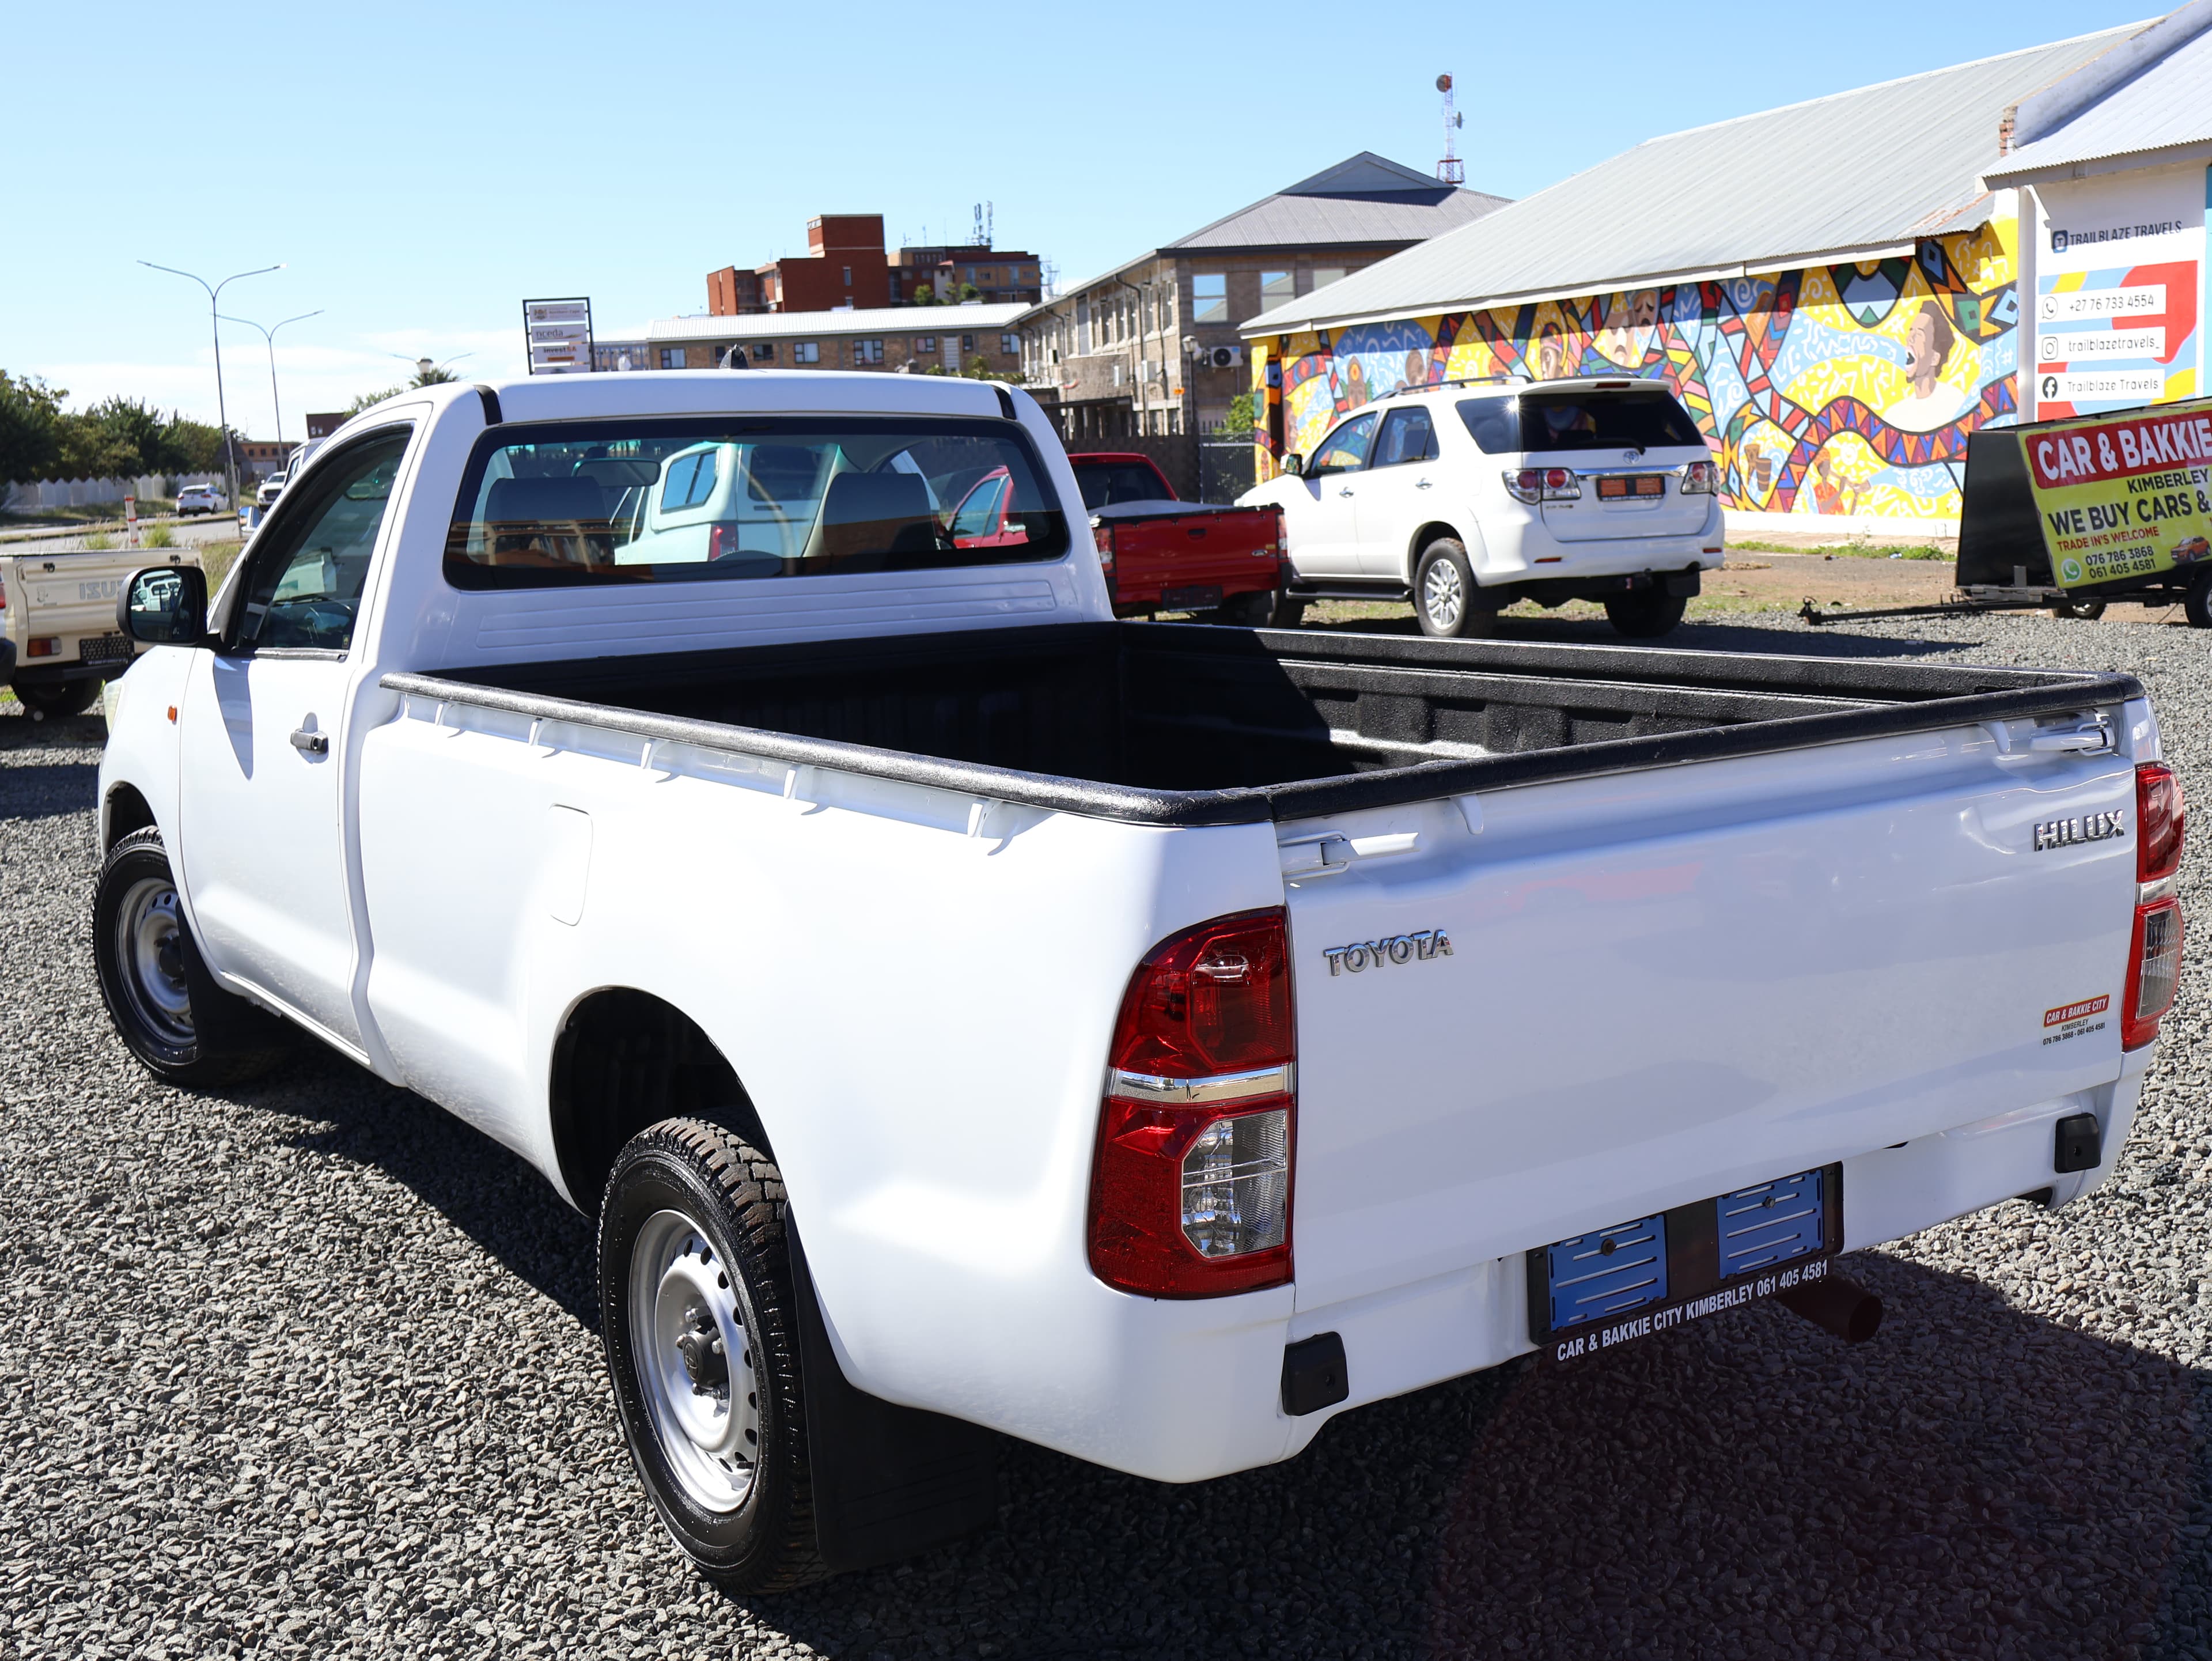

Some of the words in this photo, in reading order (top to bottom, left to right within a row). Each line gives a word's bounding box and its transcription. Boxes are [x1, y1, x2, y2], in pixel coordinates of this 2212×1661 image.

[2070, 226, 2131, 246] TRAILBLAZE
[2134, 220, 2182, 239] TRAVELS
[2070, 299, 2086, 312] +27
[2090, 298, 2103, 310] 76
[2105, 297, 2124, 309] 733
[2127, 294, 2154, 308] 4554
[2069, 335, 2160, 352] trailblazetravels_
[2067, 381, 2116, 392] Trailblaze
[2120, 378, 2159, 391] Travels
[2037, 435, 2096, 480] CAR
[2097, 432, 2119, 472] &
[2118, 418, 2212, 468] BAKKIE
[2126, 468, 2209, 494] KIMBERLEY
[2047, 508, 2086, 536] WE
[2088, 501, 2130, 531] BUY
[2137, 493, 2192, 523] CARS
[2196, 490, 2211, 513] &
[2057, 537, 2090, 552] TRADE
[2090, 534, 2109, 547] IN'S
[2111, 526, 2160, 544] WELCOME
[2085, 553, 2105, 566] 076
[2106, 549, 2126, 562] 786
[2127, 546, 2154, 559] 3868
[2089, 566, 2108, 579] 061
[2109, 562, 2130, 576] 405
[2131, 559, 2156, 572] 4581
[79, 580, 124, 599] ISU
[2034, 809, 2124, 852] HILUX
[1323, 929, 1454, 976] TOYOTA
[2046, 1011, 2060, 1024] CAR
[2061, 1009, 2066, 1019] &
[2068, 1002, 2091, 1018] BAKKIE
[2092, 998, 2107, 1012] CITY
[2043, 1037, 2052, 1046] 076
[2052, 1034, 2061, 1043] 786
[2062, 1031, 2074, 1041] 3868
[2095, 1022, 2105, 1031] 4581
[2061, 1018, 2089, 1032] KIMBERLEY
[1557, 1336, 1585, 1362] CAR
[1588, 1334, 1598, 1352] &
[1602, 1316, 1650, 1348] BAKKIE
[1653, 1307, 1683, 1331] CITY
[1686, 1283, 1754, 1321] KIMBERLEY
[1756, 1278, 1777, 1297] 061
[1779, 1271, 1800, 1289] 405
[1802, 1259, 1828, 1281] 4581
